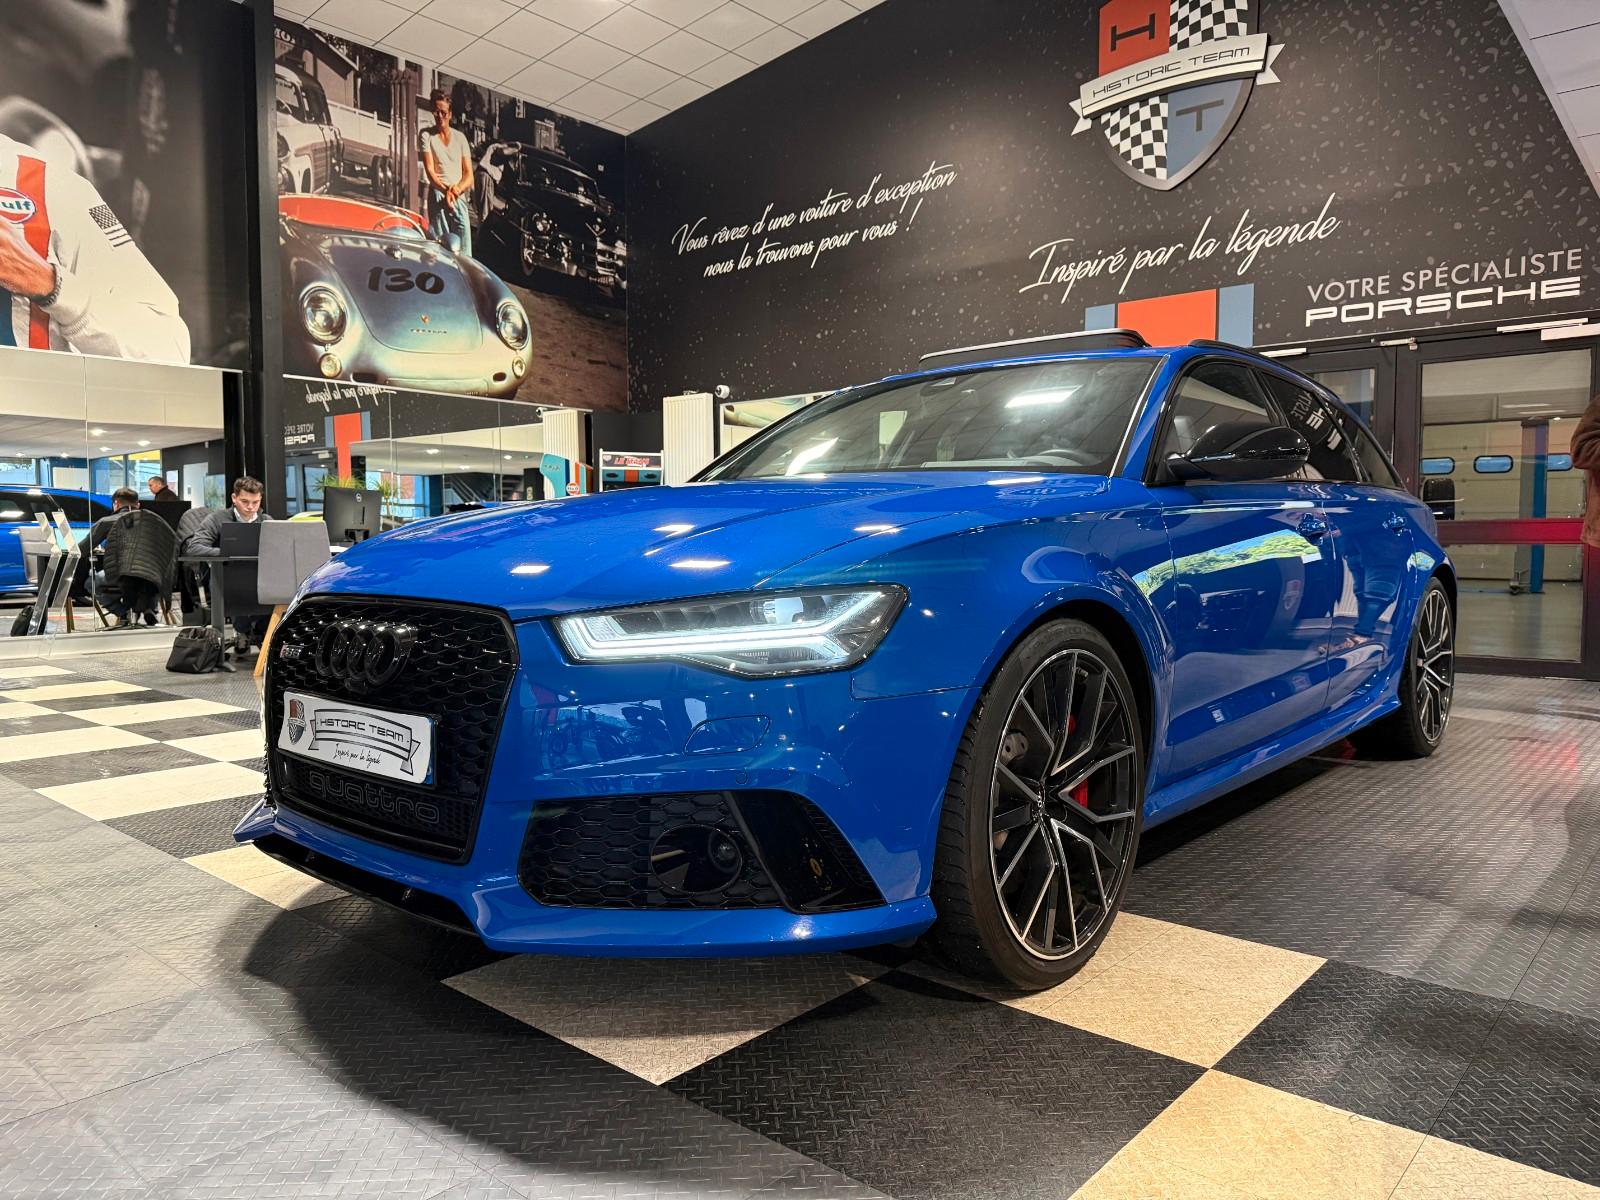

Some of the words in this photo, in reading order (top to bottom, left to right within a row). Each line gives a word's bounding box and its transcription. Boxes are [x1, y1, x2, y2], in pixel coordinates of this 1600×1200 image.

[1092, 61, 1181, 98] HISTORIC
[1188, 47, 1250, 66] TEAM
[671, 216, 709, 255] Vous
[711, 225, 750, 245] rêvez
[752, 202, 798, 235] d'une
[799, 188, 853, 224] voiture
[856, 160, 958, 214] d'exception
[703, 259, 736, 278] nous
[737, 241, 754, 270] la
[755, 237, 815, 266] trouvons
[810, 230, 859, 268] pour
[862, 220, 899, 242] vous
[1018, 238, 1128, 304] Inspiré
[1119, 243, 1183, 295] par
[1188, 215, 1221, 261] la
[1225, 192, 1341, 276] légende
[367, 266, 445, 295] 130
[1304, 276, 1581, 327] PORSCHE
[1307, 274, 1390, 303] VOTRE
[1401, 248, 1582, 292] SPÉCIALISTE
[368, 723, 404, 743] TEAM
[310, 770, 439, 824] quattro
